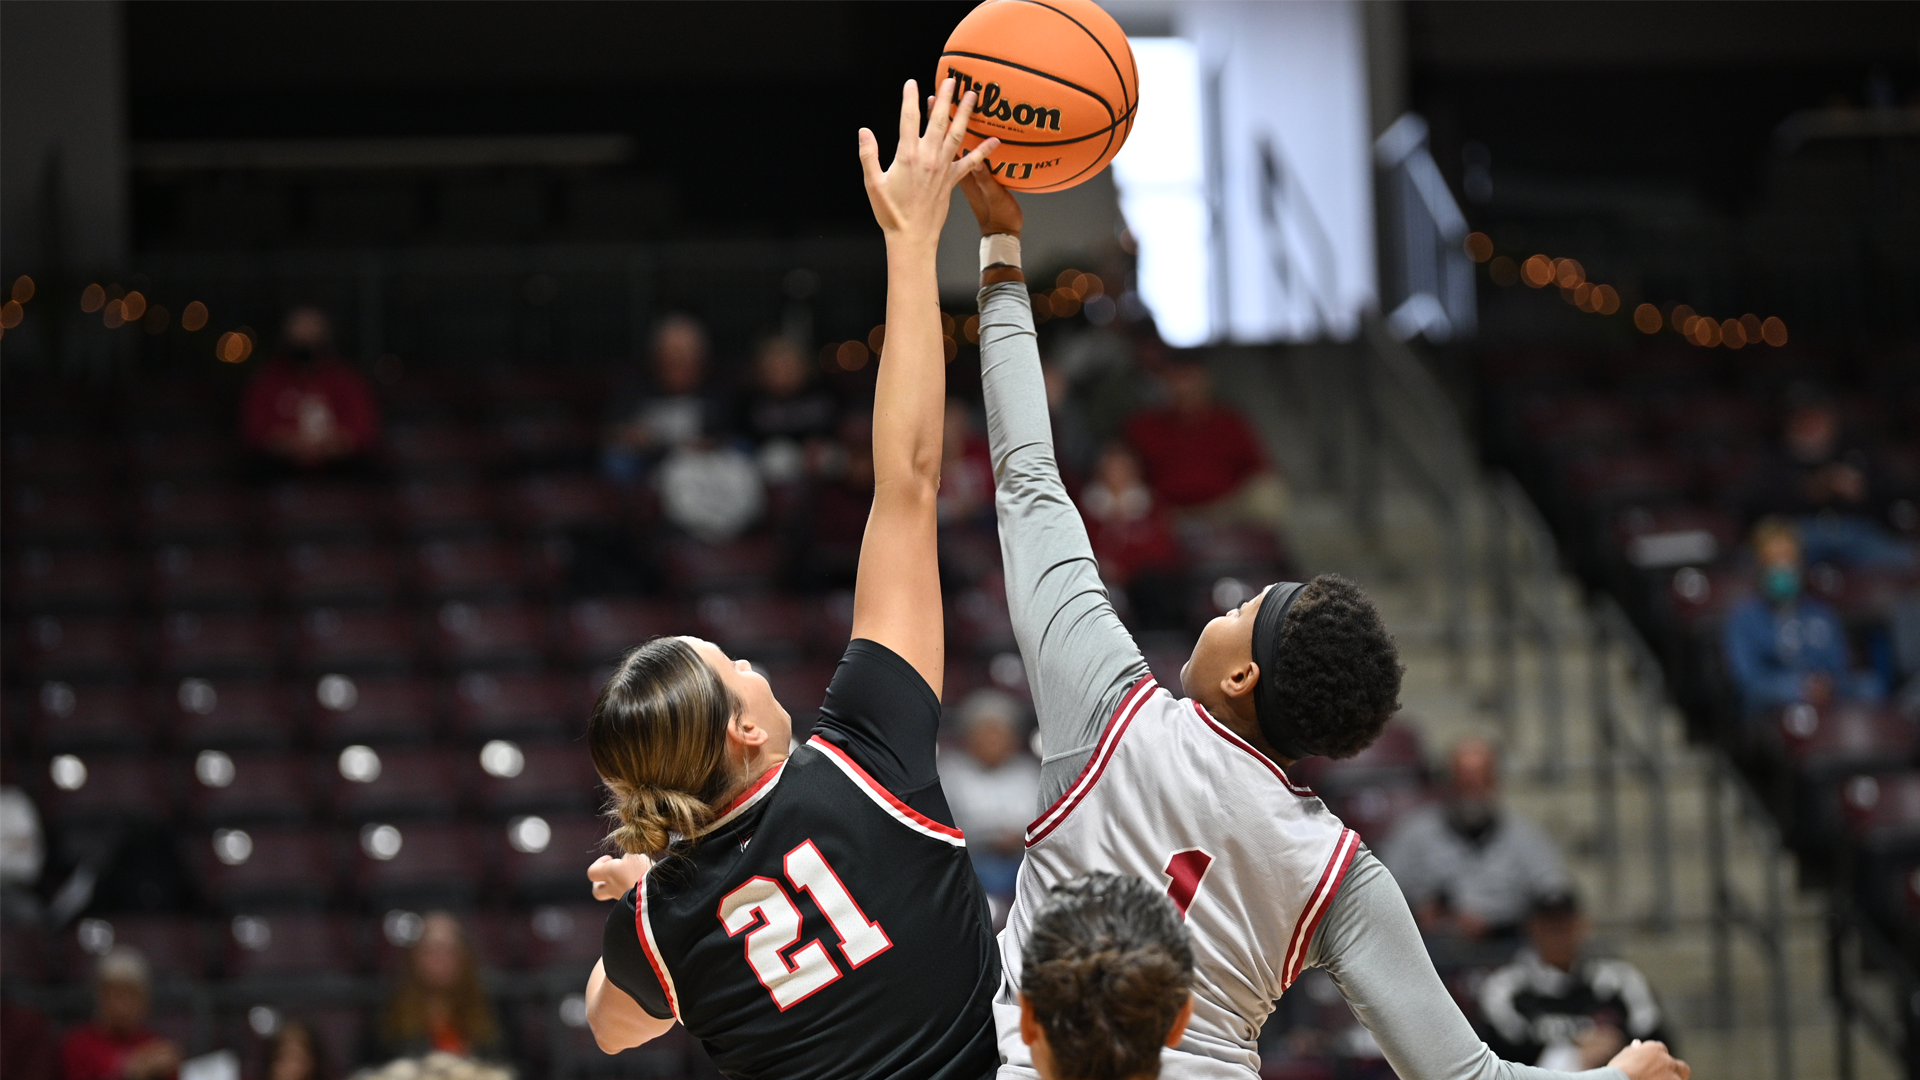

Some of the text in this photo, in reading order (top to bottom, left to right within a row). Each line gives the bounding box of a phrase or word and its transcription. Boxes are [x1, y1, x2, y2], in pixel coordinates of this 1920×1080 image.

[962, 148, 1063, 180] VO NXT
[716, 837, 894, 1013] 21
